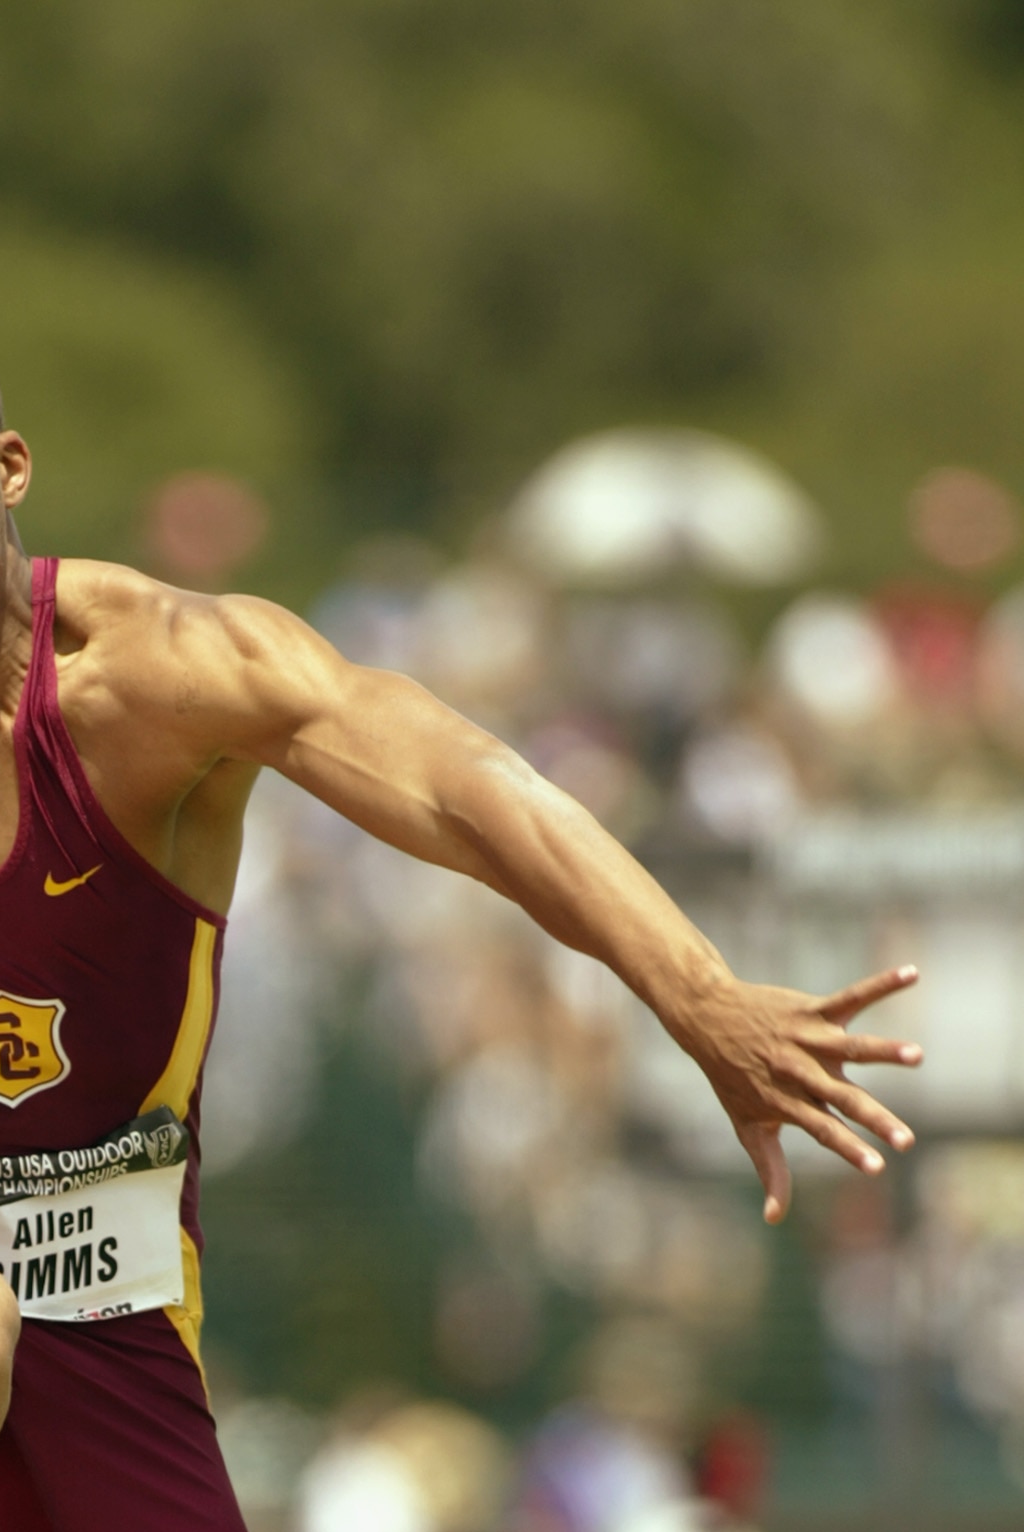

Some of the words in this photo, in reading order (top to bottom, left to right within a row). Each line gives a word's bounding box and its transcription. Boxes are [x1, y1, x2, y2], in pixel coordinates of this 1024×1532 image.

[19, 1153, 55, 1178] USA
[58, 1131, 144, 1173] OUTDOOR
[12, 1206, 94, 1250] Allen
